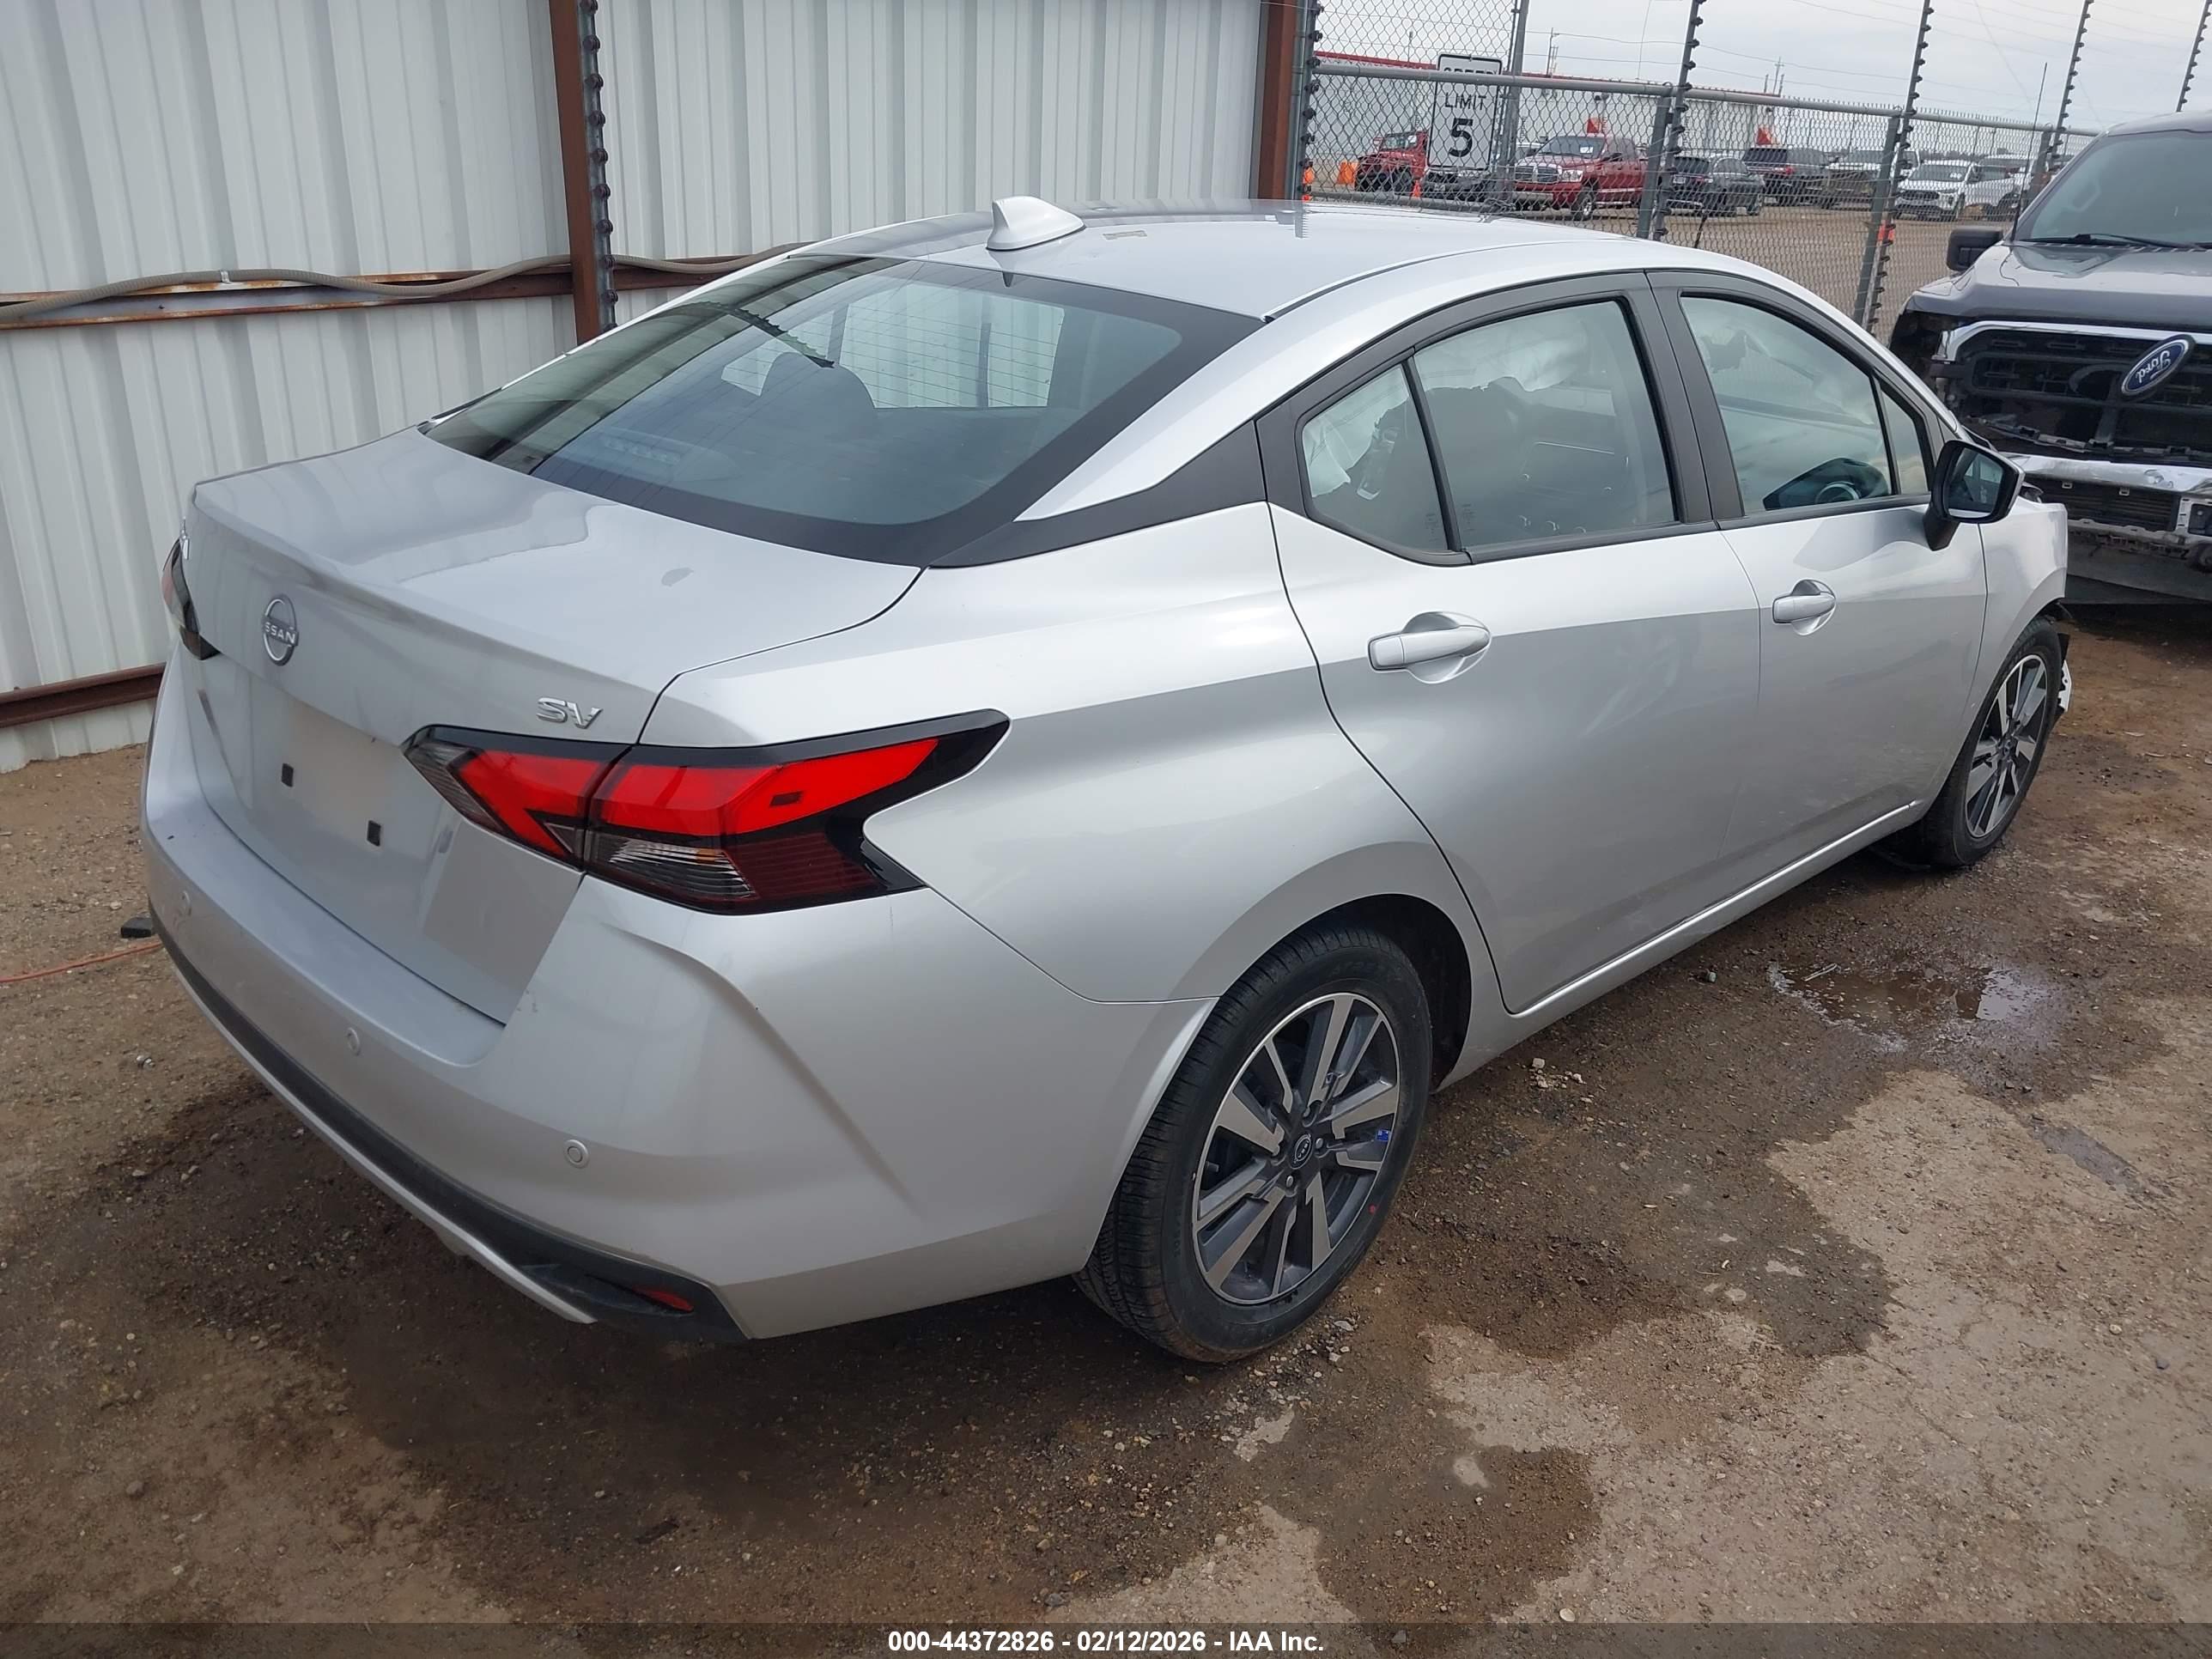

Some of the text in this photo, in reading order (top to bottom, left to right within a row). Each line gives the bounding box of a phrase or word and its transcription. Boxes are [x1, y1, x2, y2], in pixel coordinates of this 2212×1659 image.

[1444, 92, 1487, 111] LIMIT
[1448, 117, 1474, 158] 5
[536, 696, 604, 730] SV
